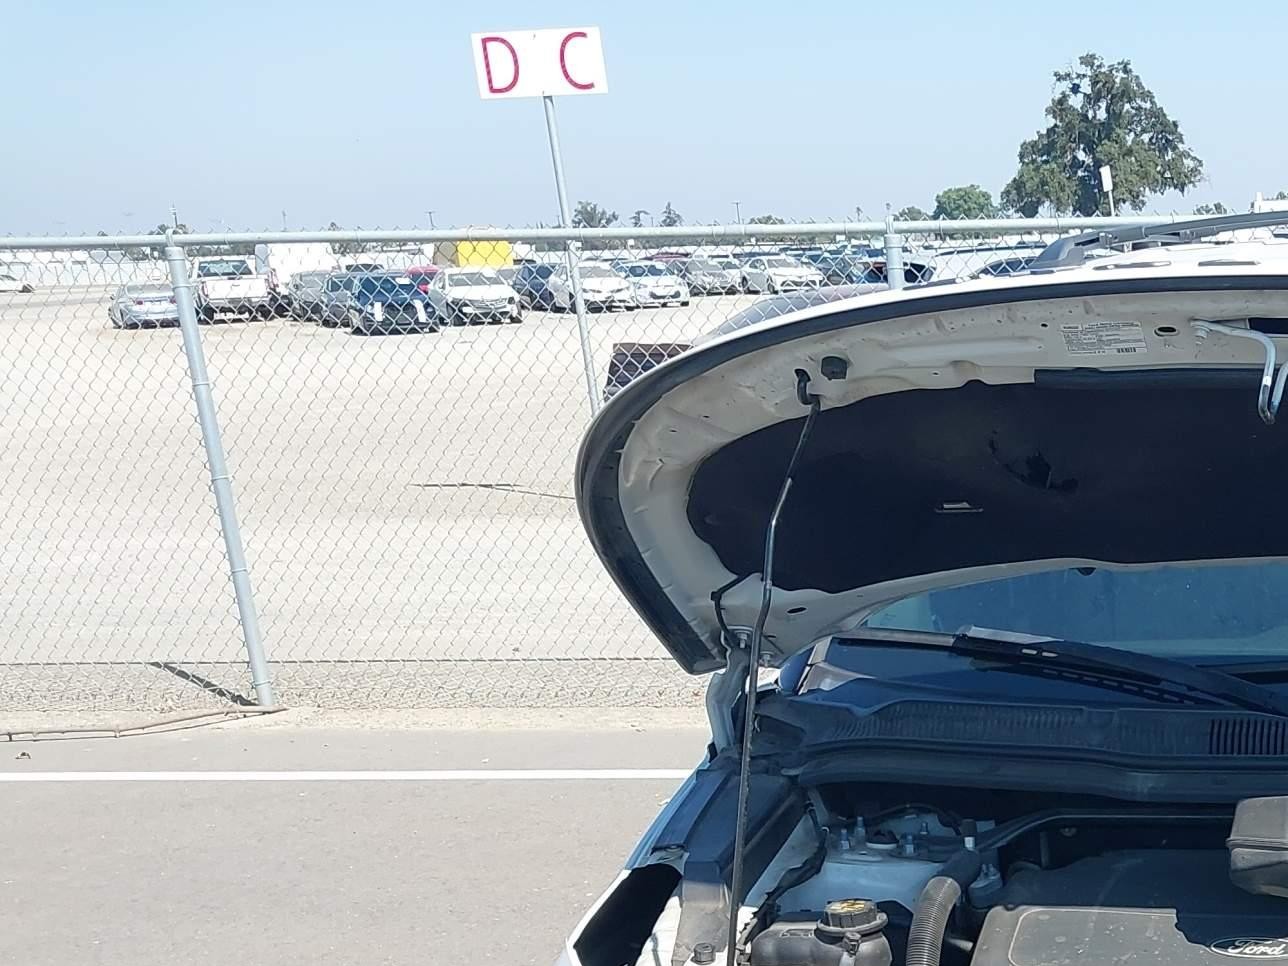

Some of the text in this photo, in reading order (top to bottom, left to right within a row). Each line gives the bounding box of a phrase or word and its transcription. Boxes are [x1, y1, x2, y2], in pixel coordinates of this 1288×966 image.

[481, 31, 595, 94] D C
[1227, 939, 1287, 955] Ford
